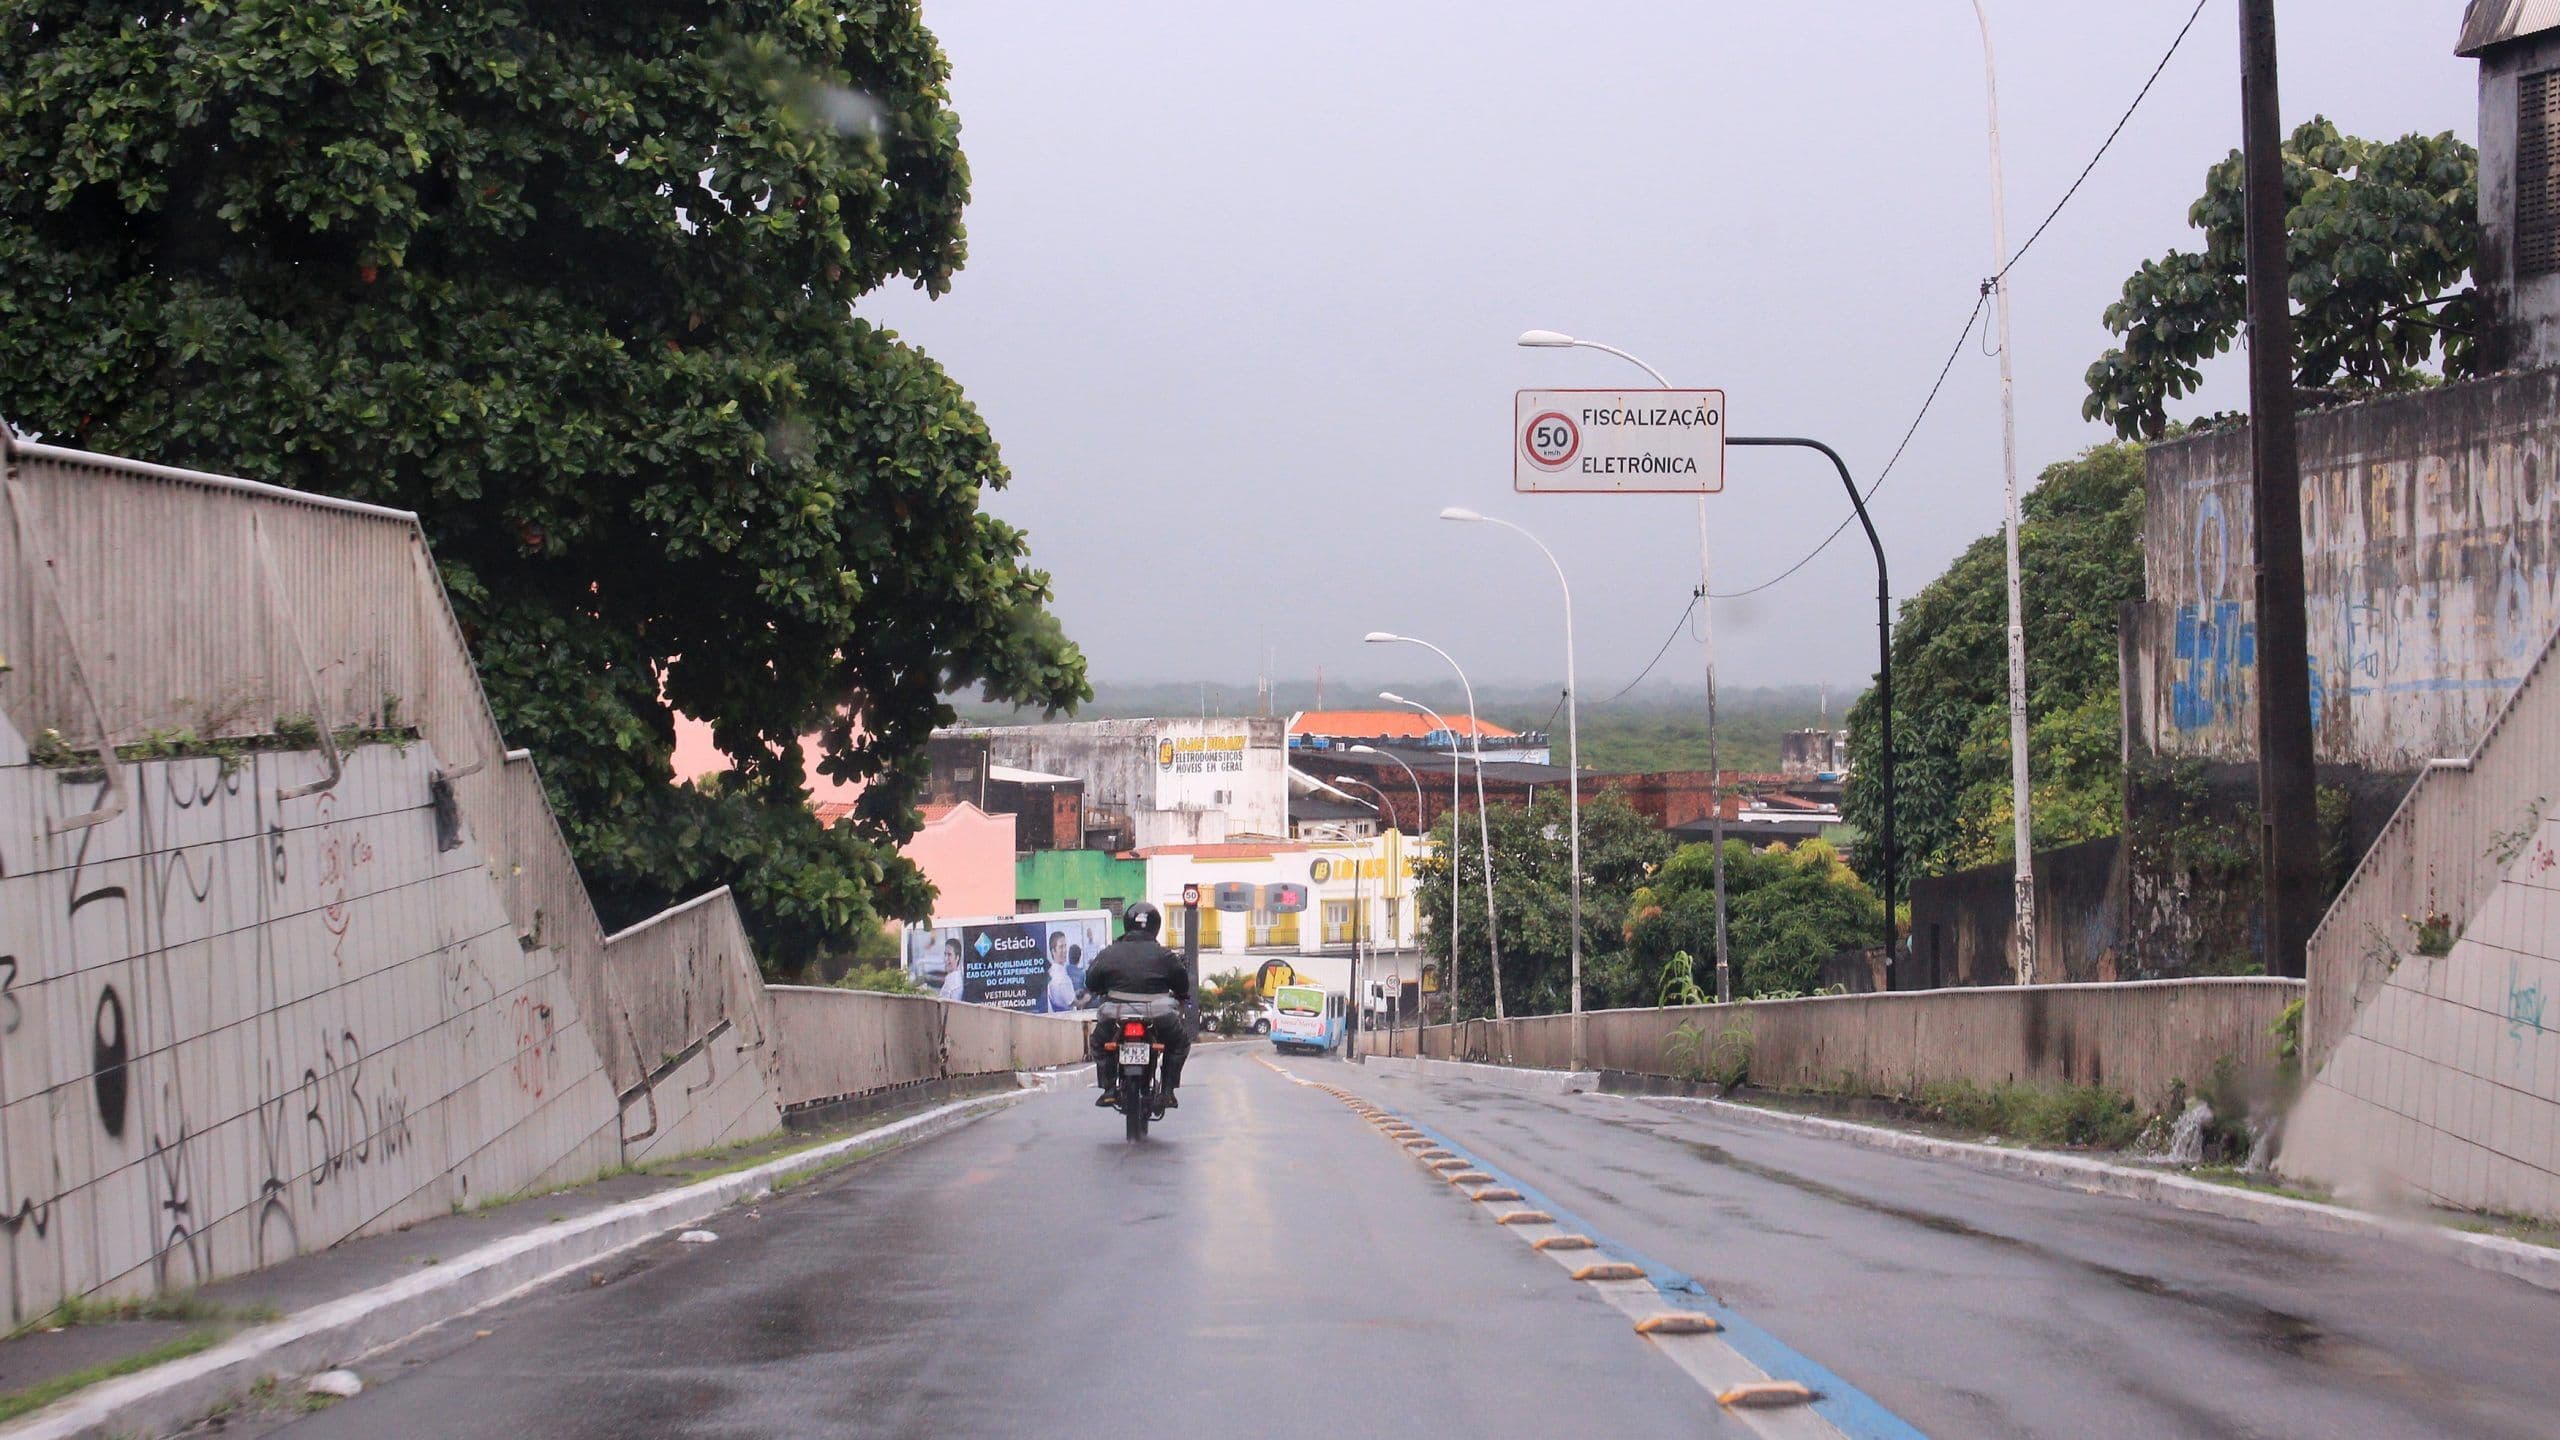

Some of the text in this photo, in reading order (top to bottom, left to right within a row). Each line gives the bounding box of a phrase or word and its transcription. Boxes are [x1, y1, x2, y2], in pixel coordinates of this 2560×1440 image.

[1583, 406, 1718, 429] FISCALIZAÇÃO
[1537, 427, 1568, 448] 50
[1582, 452, 1697, 474] ELETRÔNICA
[1221, 761, 1243, 772] GERAL
[1185, 891, 1197, 899] 50
[994, 935, 1036, 951] Estácio
[1033, 958, 1044, 966] DO
[980, 970, 996, 978] COM
[984, 989, 1027, 999] VESTIBULAR
